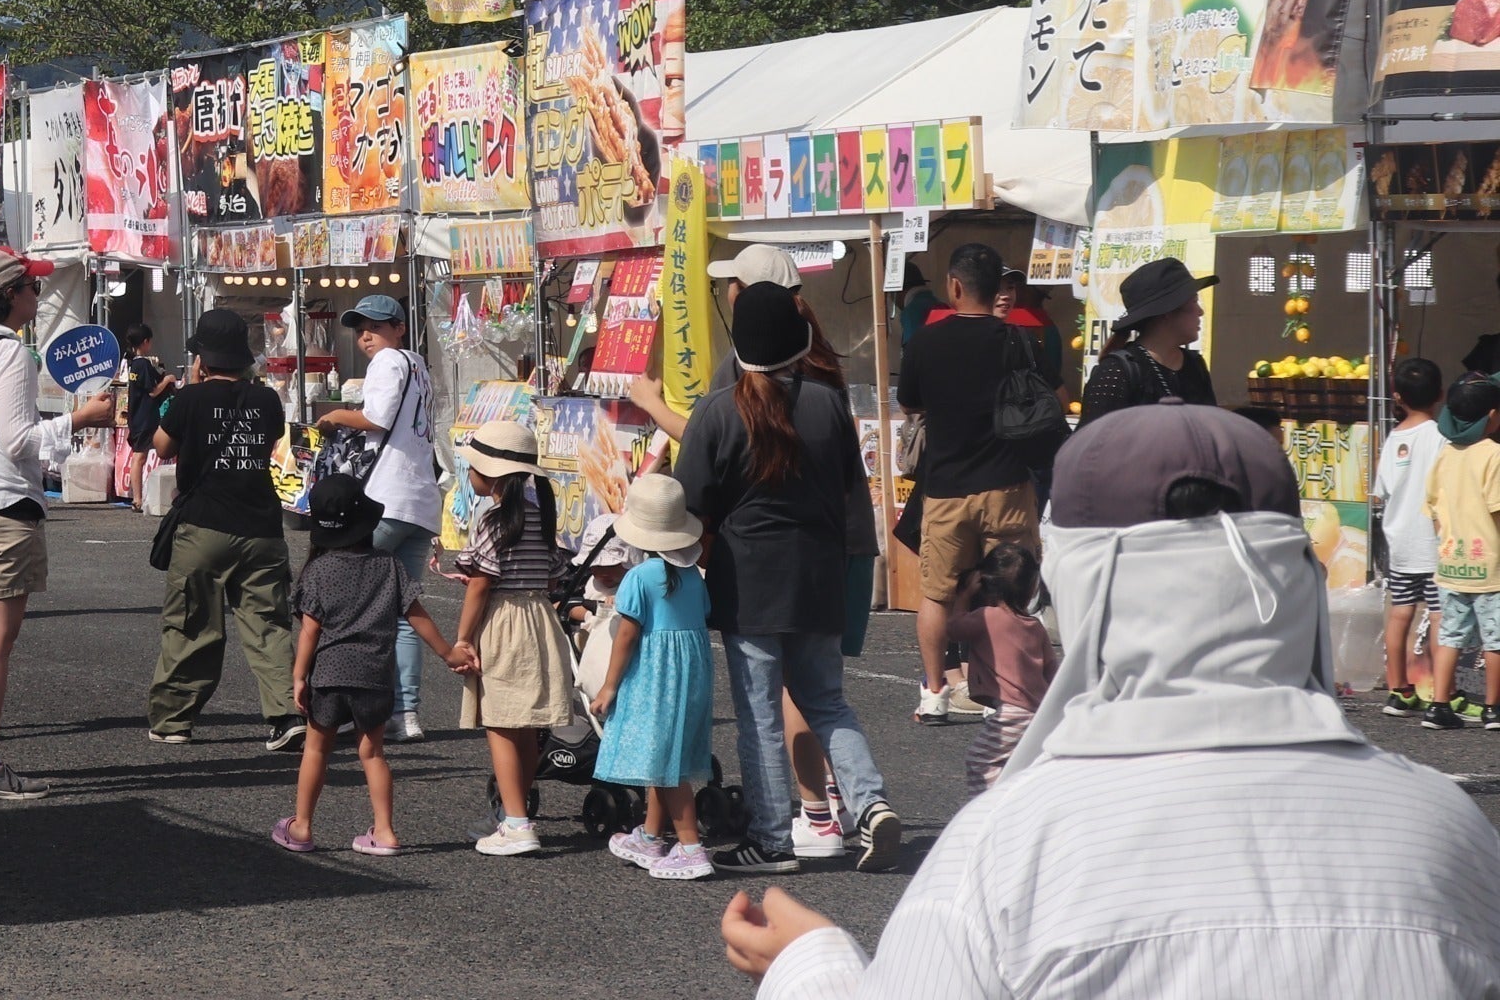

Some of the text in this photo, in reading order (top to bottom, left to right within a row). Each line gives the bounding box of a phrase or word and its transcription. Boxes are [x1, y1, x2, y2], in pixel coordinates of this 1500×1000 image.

[546, 53, 581, 82] SUPER
[53, 332, 104, 361] がんばれ!
[63, 359, 113, 385] GO GO JAPAN!
[213, 407, 224, 419] IT
[549, 433, 580, 457] SUPER
